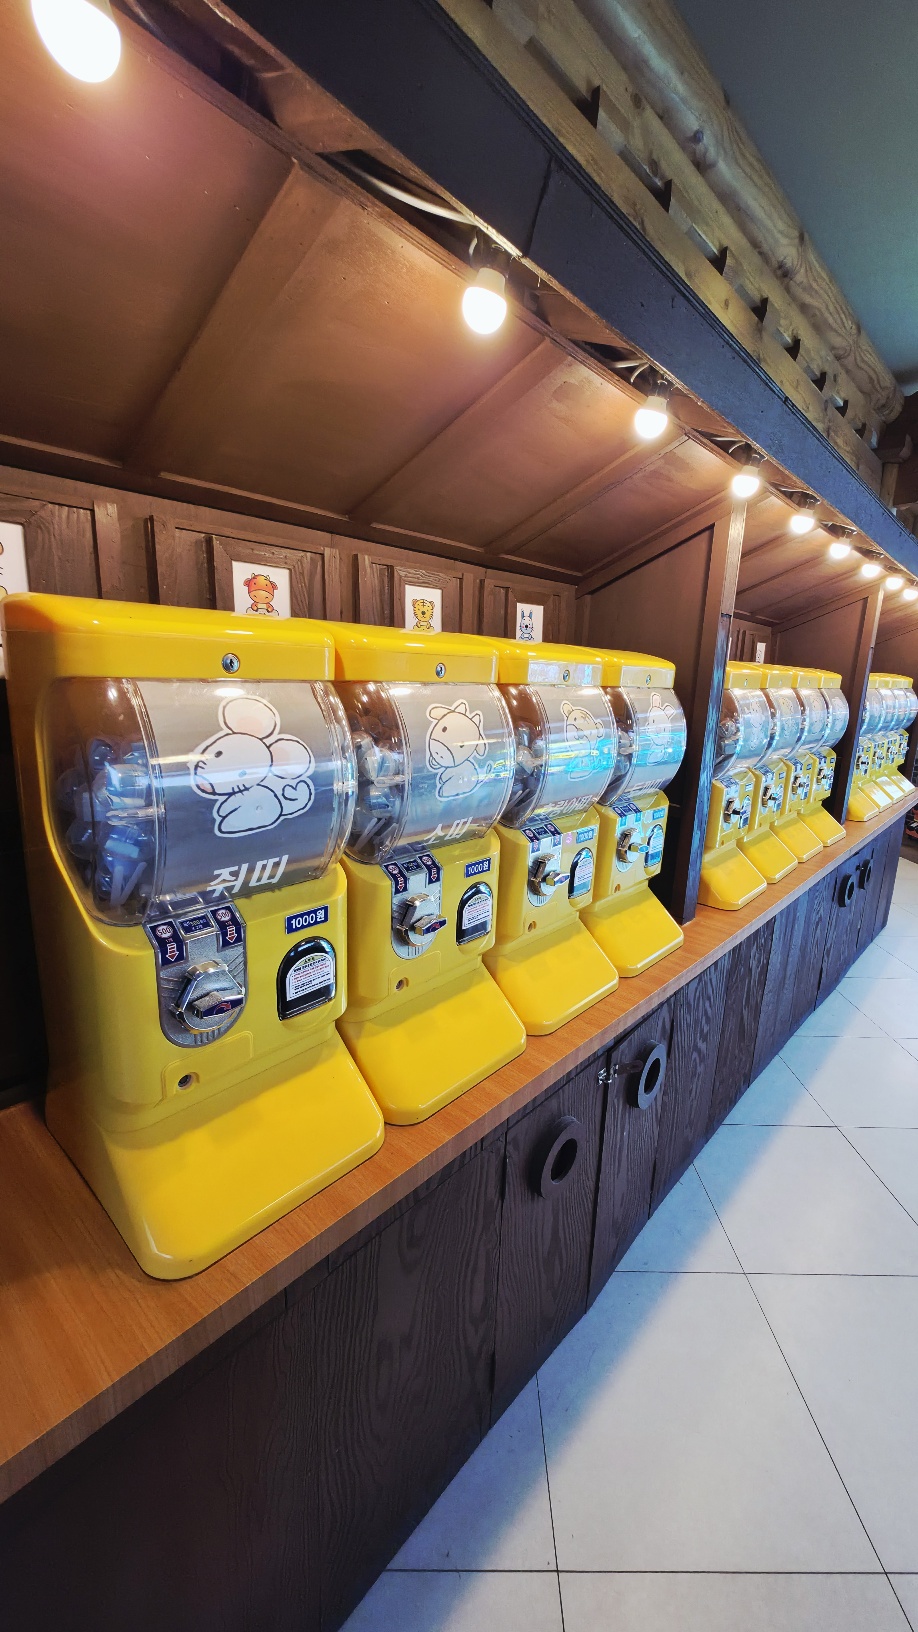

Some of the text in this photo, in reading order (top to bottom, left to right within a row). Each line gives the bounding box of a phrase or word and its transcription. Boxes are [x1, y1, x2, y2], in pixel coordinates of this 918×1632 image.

[418, 816, 473, 846] 소띠
[206, 854, 289, 897] 쥐띠
[467, 860, 489, 875] 1000원
[290, 909, 325, 929] 1000원
